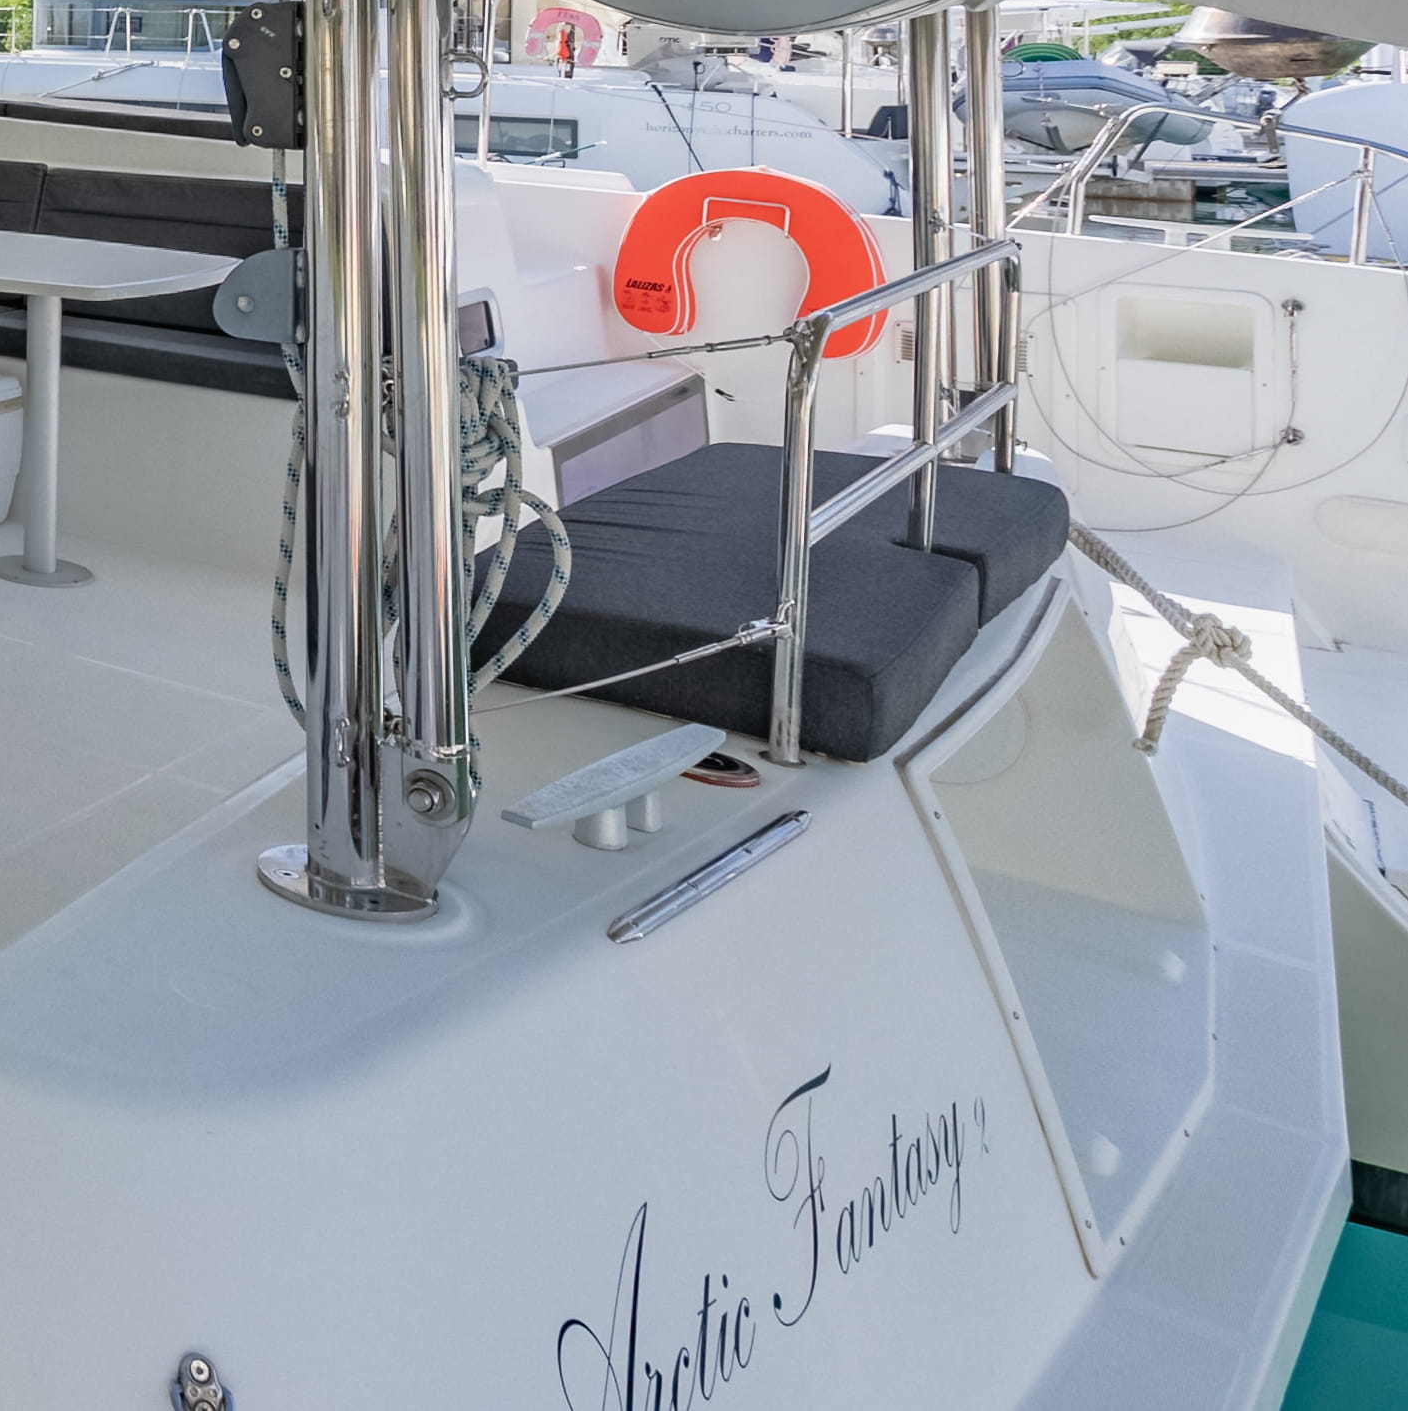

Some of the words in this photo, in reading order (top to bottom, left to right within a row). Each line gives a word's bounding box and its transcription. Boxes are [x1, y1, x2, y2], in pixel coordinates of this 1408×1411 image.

[626, 278, 665, 292] LALIZAS
[557, 1201, 756, 1411] Arctic
[764, 1062, 965, 1327] Fantasy
